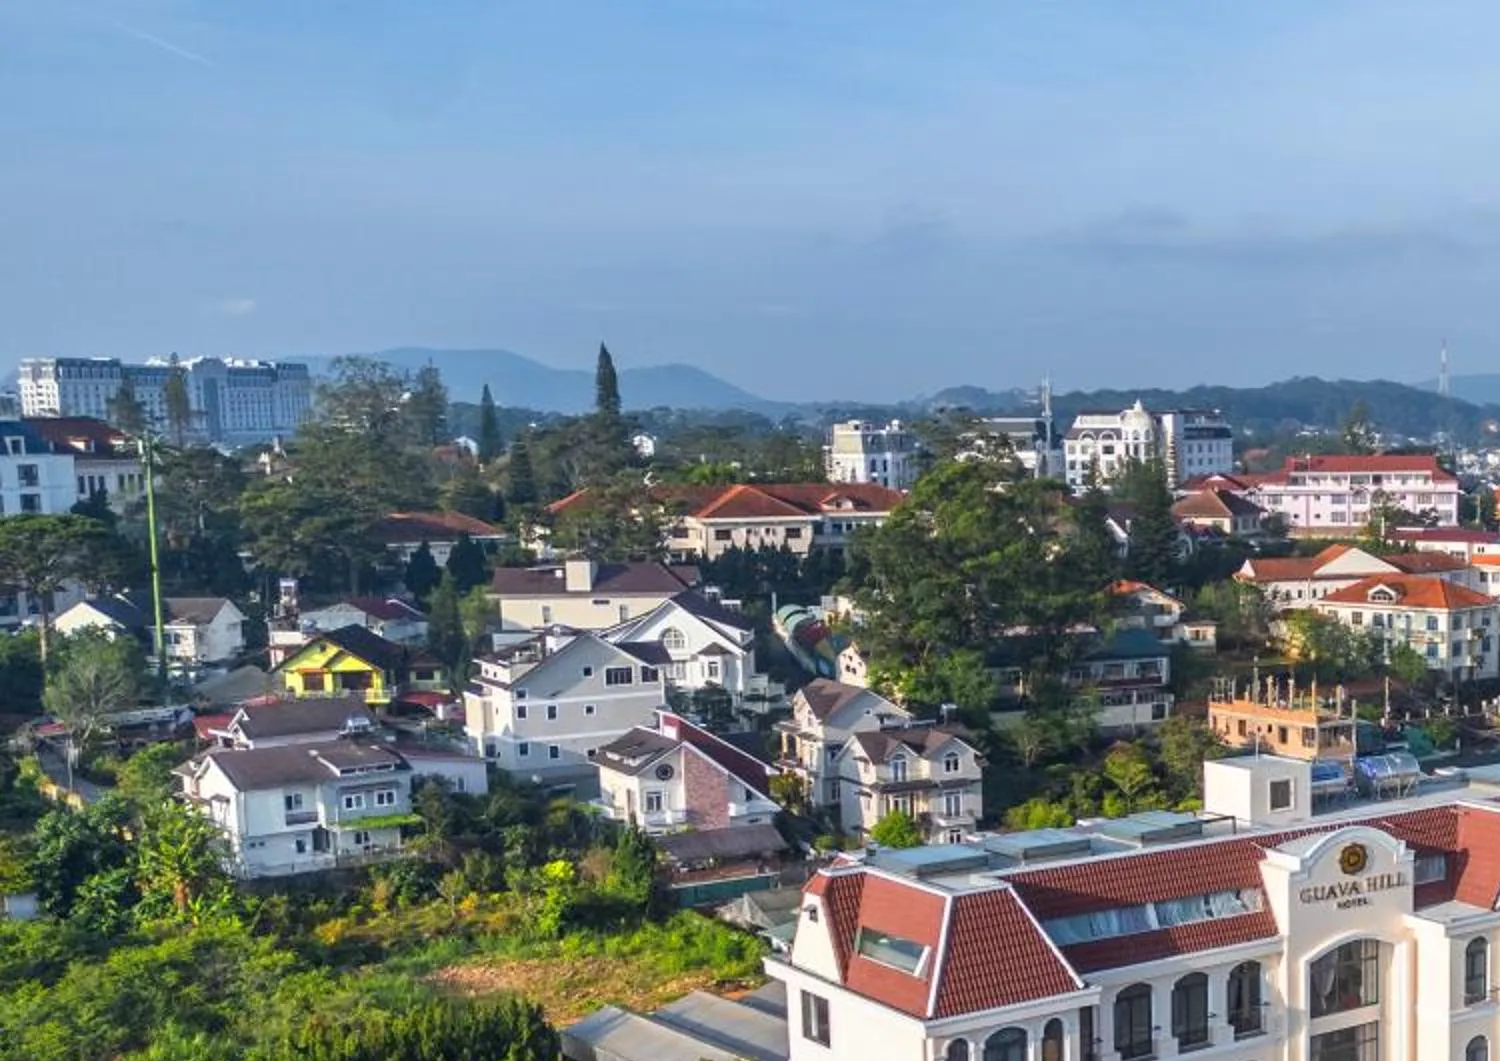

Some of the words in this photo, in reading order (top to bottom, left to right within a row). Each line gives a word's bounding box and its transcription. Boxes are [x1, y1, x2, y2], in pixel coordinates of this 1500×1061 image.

[1300, 880, 1361, 904] GUAVA
[1366, 871, 1407, 893] HILL
[1337, 896, 1370, 909] HOTEL
